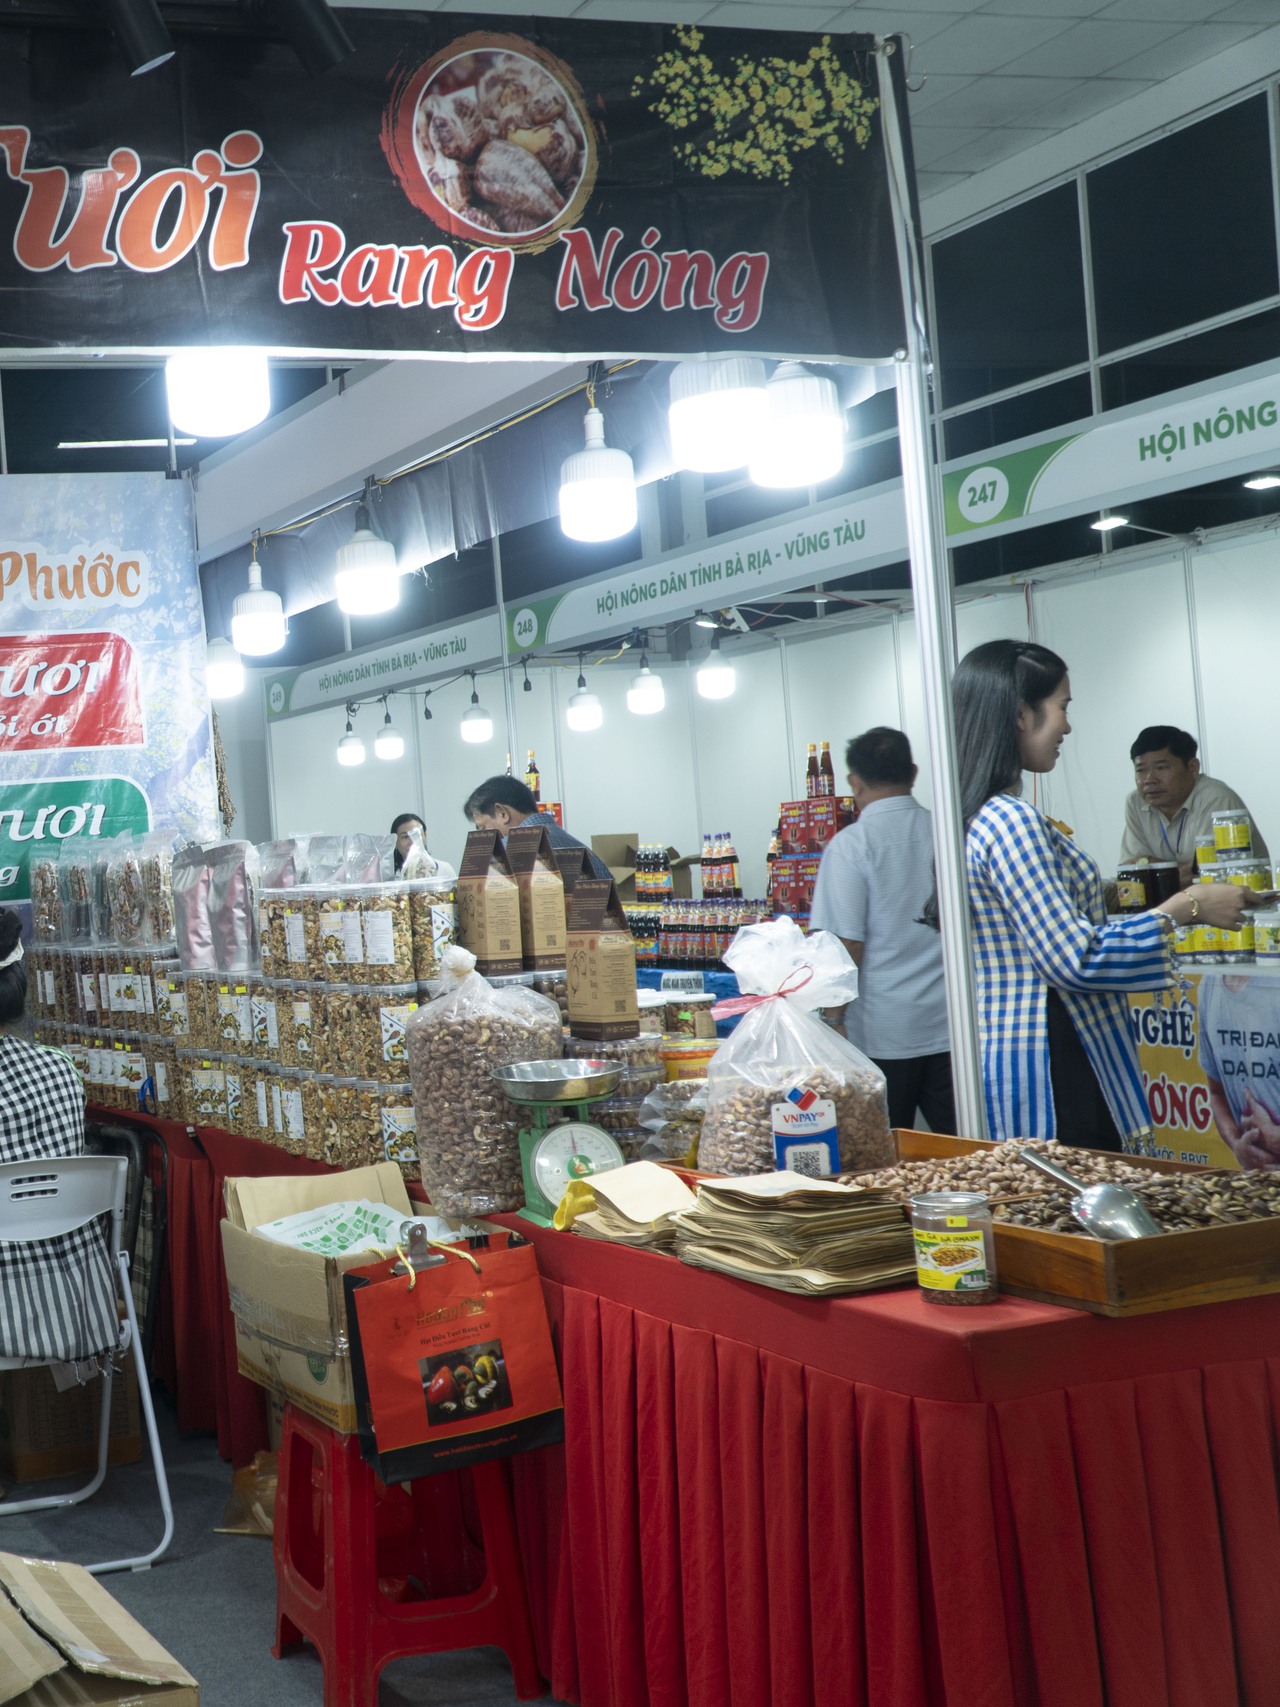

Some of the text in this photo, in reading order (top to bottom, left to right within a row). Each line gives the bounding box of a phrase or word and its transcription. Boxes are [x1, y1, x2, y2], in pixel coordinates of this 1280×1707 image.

[279, 221, 769, 332] Rang Nóng
[1139, 400, 1278, 462] HỘI NÔNG
[967, 480, 998, 507] 247
[596, 591, 618, 616] HỘI
[620, 581, 657, 607] NÔNG
[660, 571, 687, 596] DÂN
[689, 562, 721, 588] TỈNH
[725, 551, 745, 577] BÀ
[747, 548, 773, 575] RỊA
[784, 532, 830, 560] VŨNG
[833, 519, 866, 547] TÀU
[517, 619, 533, 636] 248
[318, 673, 332, 693] HỘI
[332, 668, 354, 687] NÔNG
[355, 662, 371, 682] DÂN
[371, 657, 391, 676] TỈNH
[391, 653, 403, 671] BÀ
[403, 652, 418, 671] RỊA
[423, 642, 449, 661] VŨNG
[451, 637, 467, 654] TÀU
[31, 711, 70, 737] ớt
[1217, 1029, 1280, 1052] TRỊ ĐA
[1223, 1055, 1280, 1082] DẠ DÀ
[1144, 1073, 1211, 1130] ƠNG
